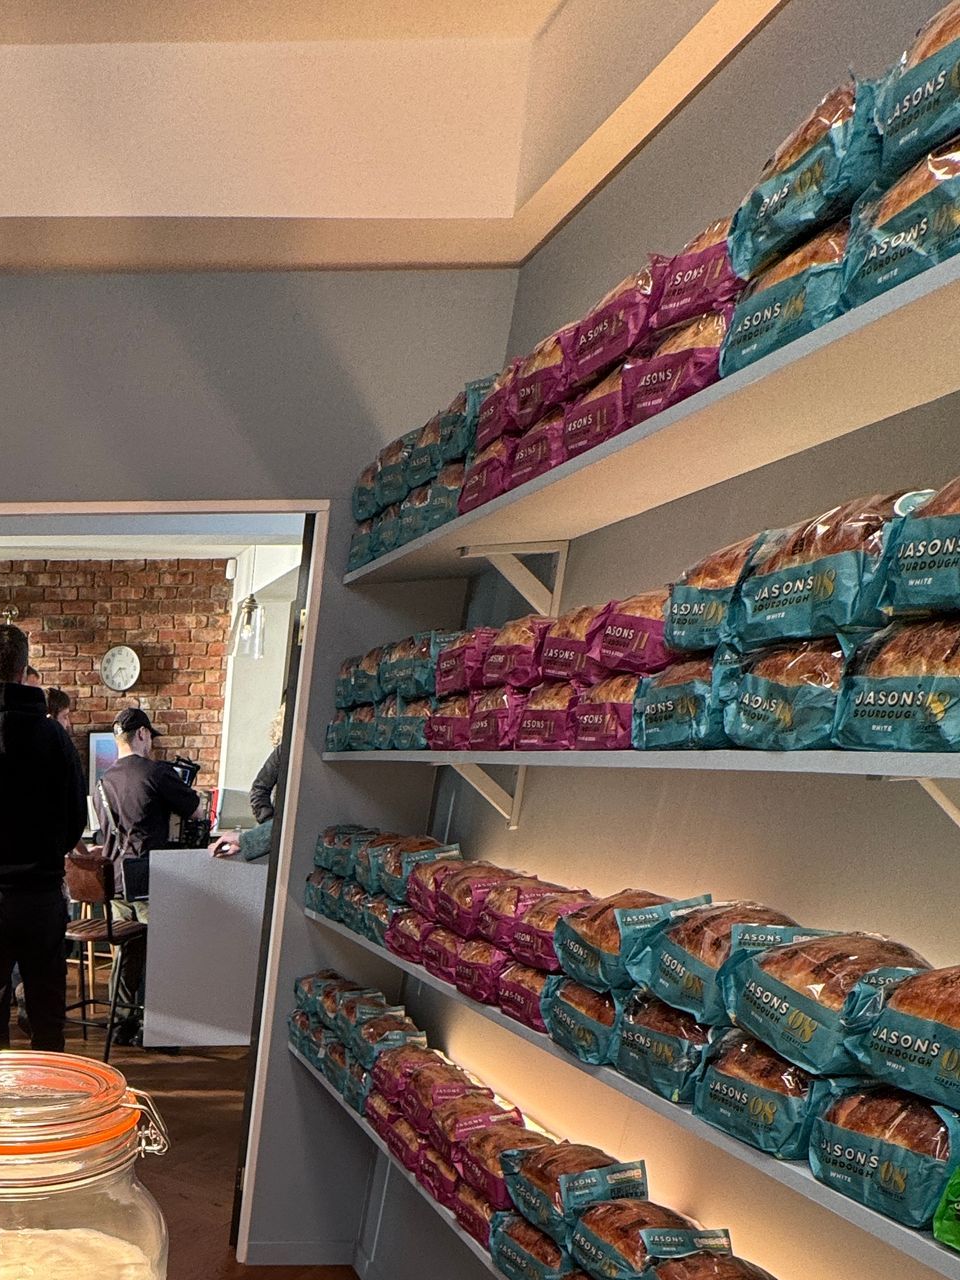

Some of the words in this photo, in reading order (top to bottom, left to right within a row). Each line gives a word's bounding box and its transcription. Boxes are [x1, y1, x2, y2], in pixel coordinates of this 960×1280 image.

[908, 577, 933, 586] WHITE
[869, 1040, 933, 1067] SOURDOUGH
[886, 1060, 906, 1073] WHITE
[830, 1171, 852, 1183] WHITE
